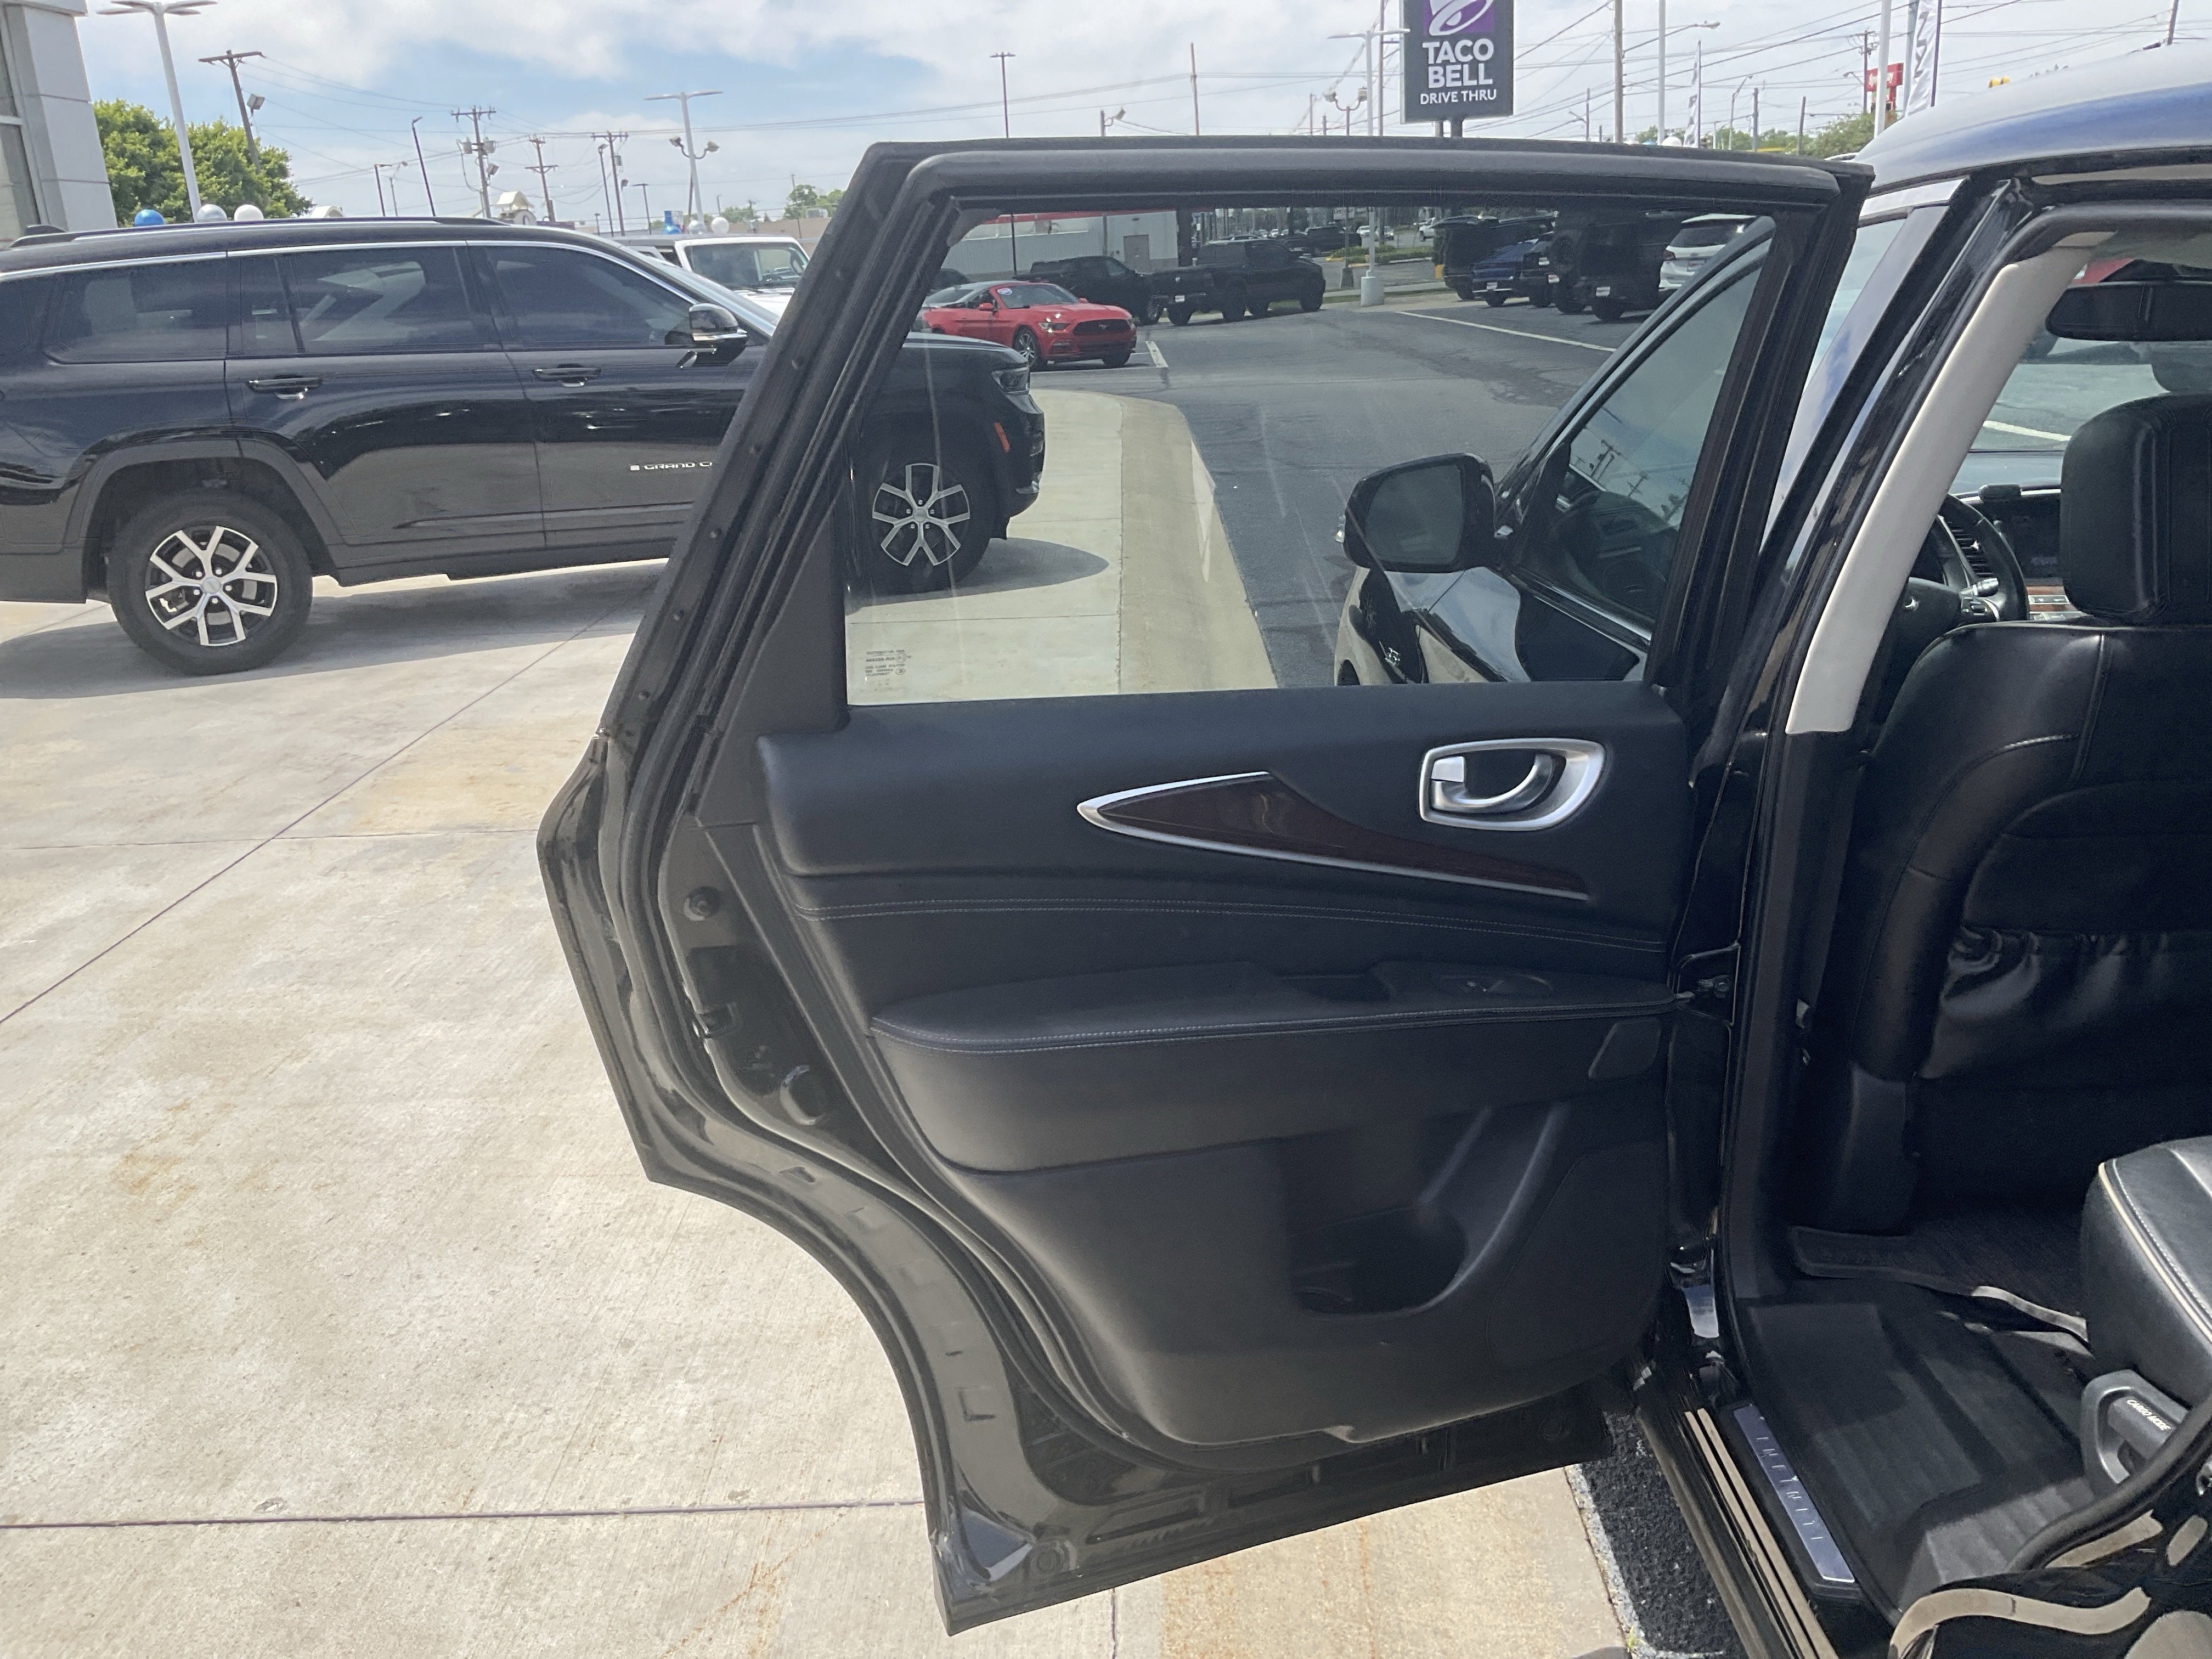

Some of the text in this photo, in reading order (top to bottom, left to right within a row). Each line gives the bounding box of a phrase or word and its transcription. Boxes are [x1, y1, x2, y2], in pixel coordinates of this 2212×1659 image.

[1422, 38, 1494, 64] TACO
[1428, 63, 1493, 88] BELL
[1420, 88, 1497, 105] DRIVE THRU
